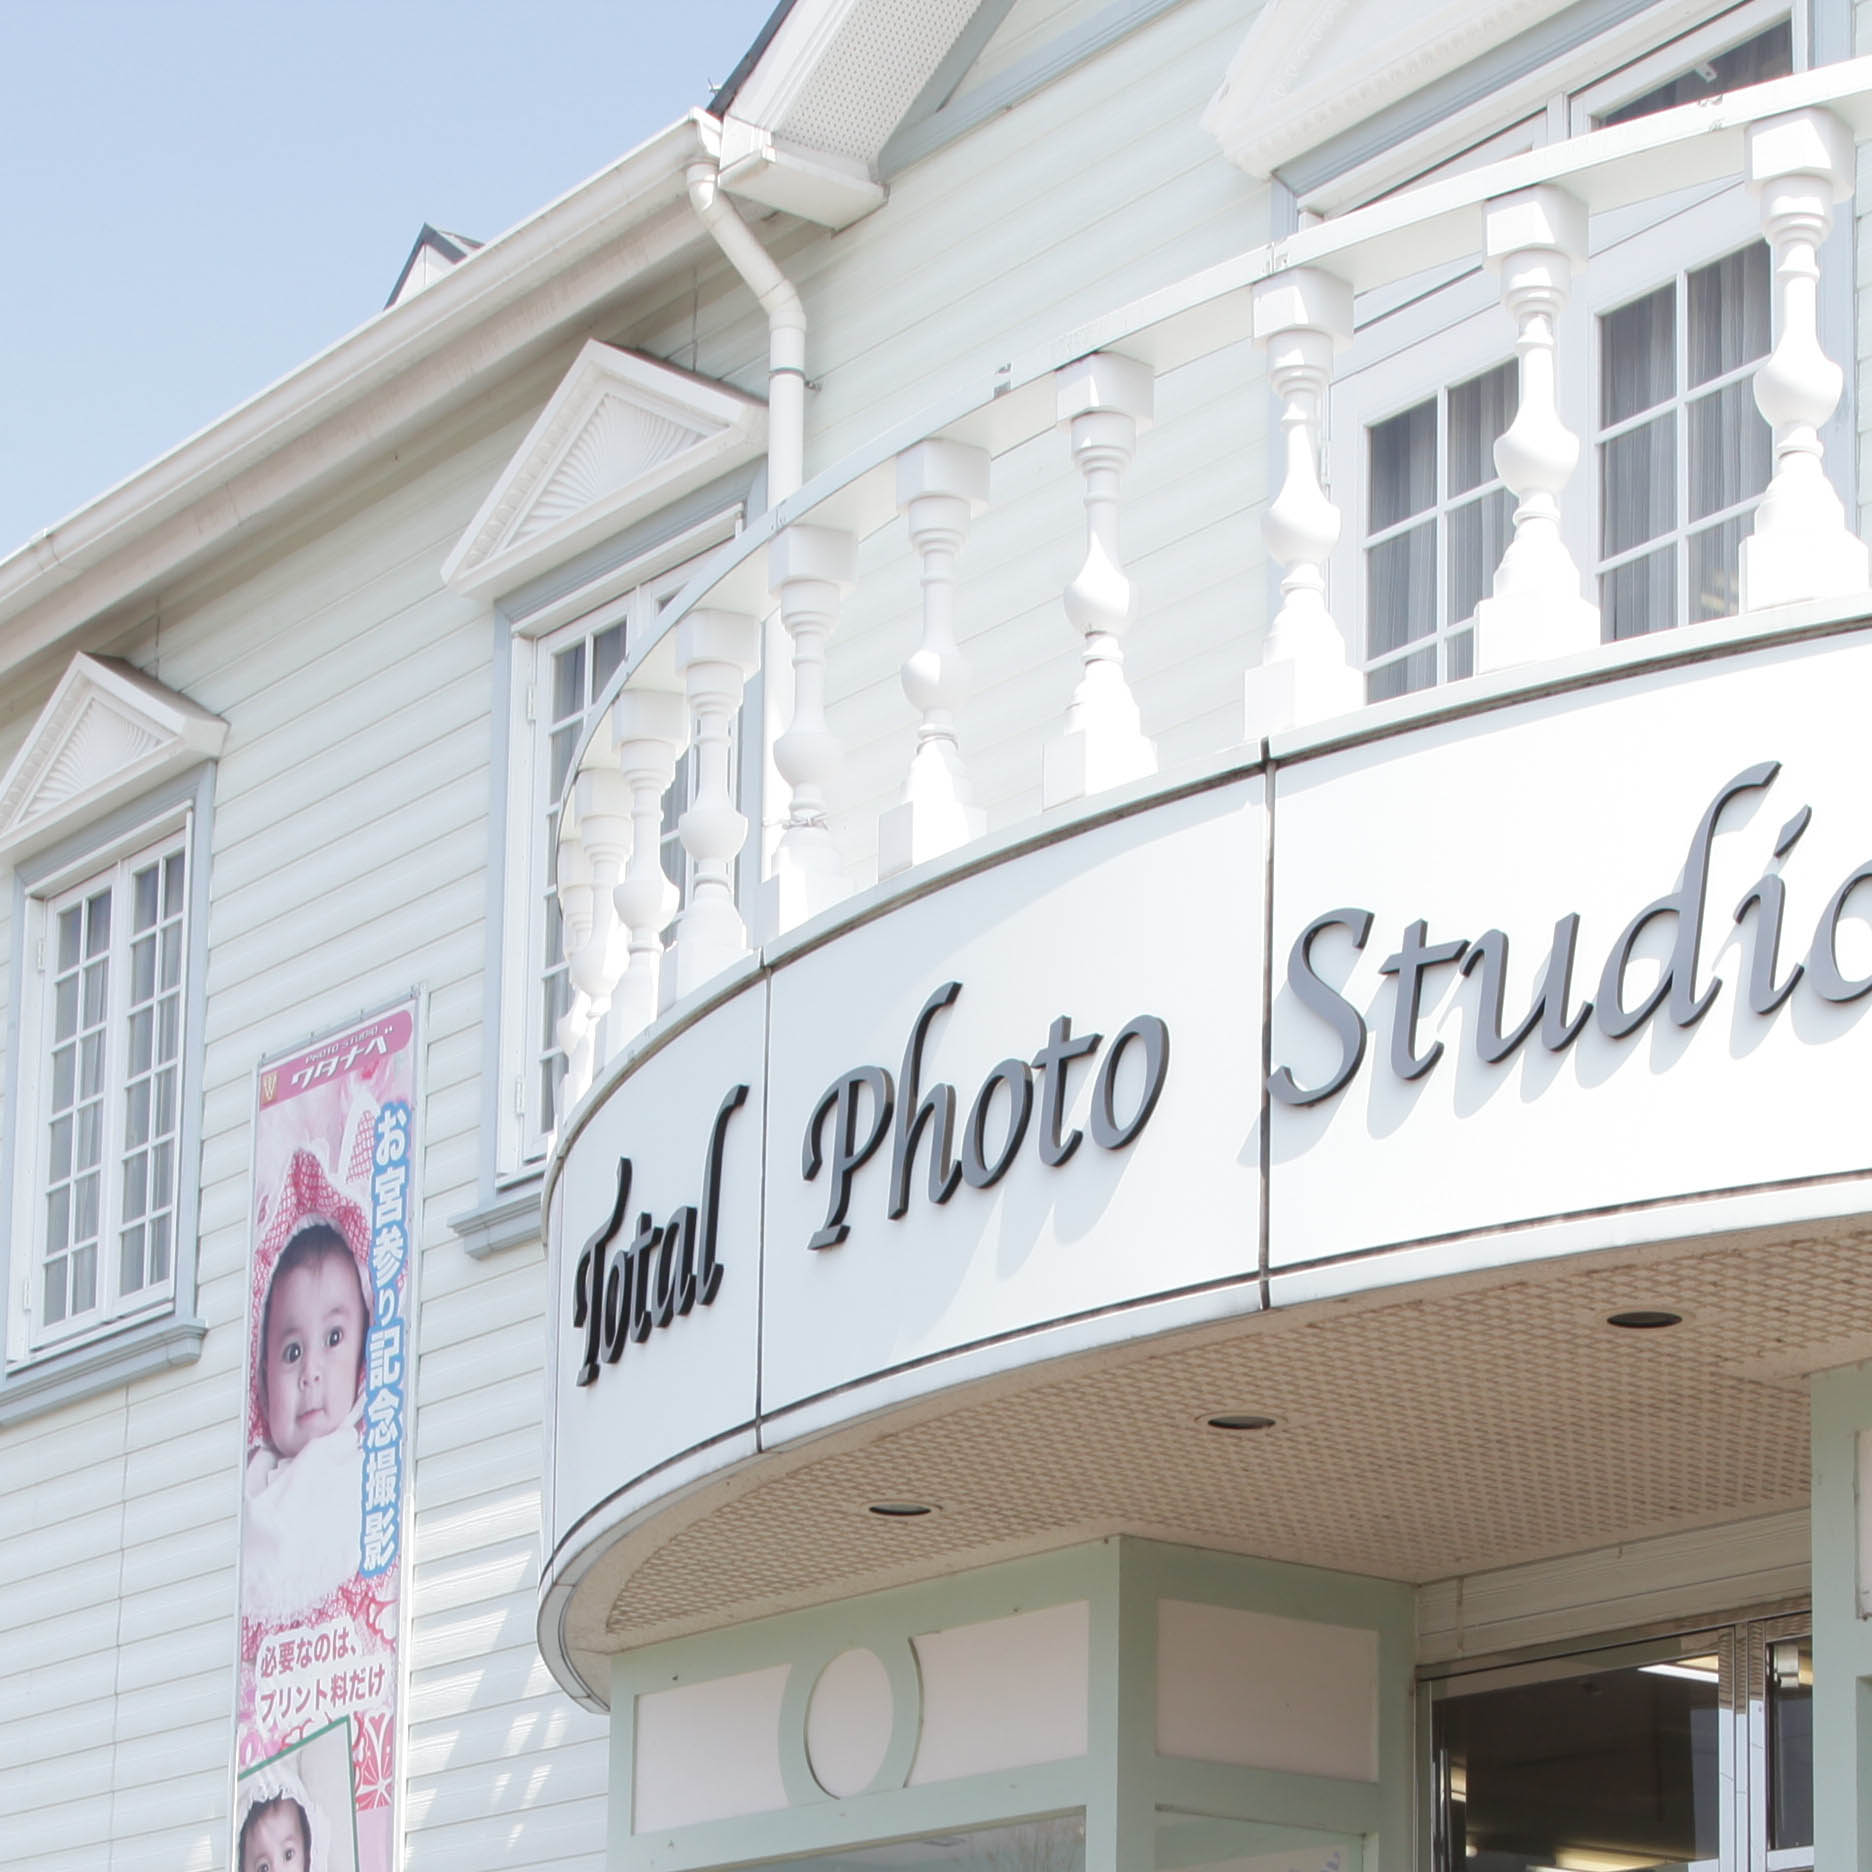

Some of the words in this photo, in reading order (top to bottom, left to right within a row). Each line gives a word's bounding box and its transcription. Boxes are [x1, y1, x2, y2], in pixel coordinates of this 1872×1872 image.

[291, 1025, 393, 1089] ワタナベ
[571, 1082, 751, 1388] Total
[801, 981, 1169, 1252] Photo
[361, 1108, 407, 1570] お宮参り記念撮影
[260, 1626, 359, 1678] 必要なのは、
[260, 1665, 385, 1722] プリント料だけ
